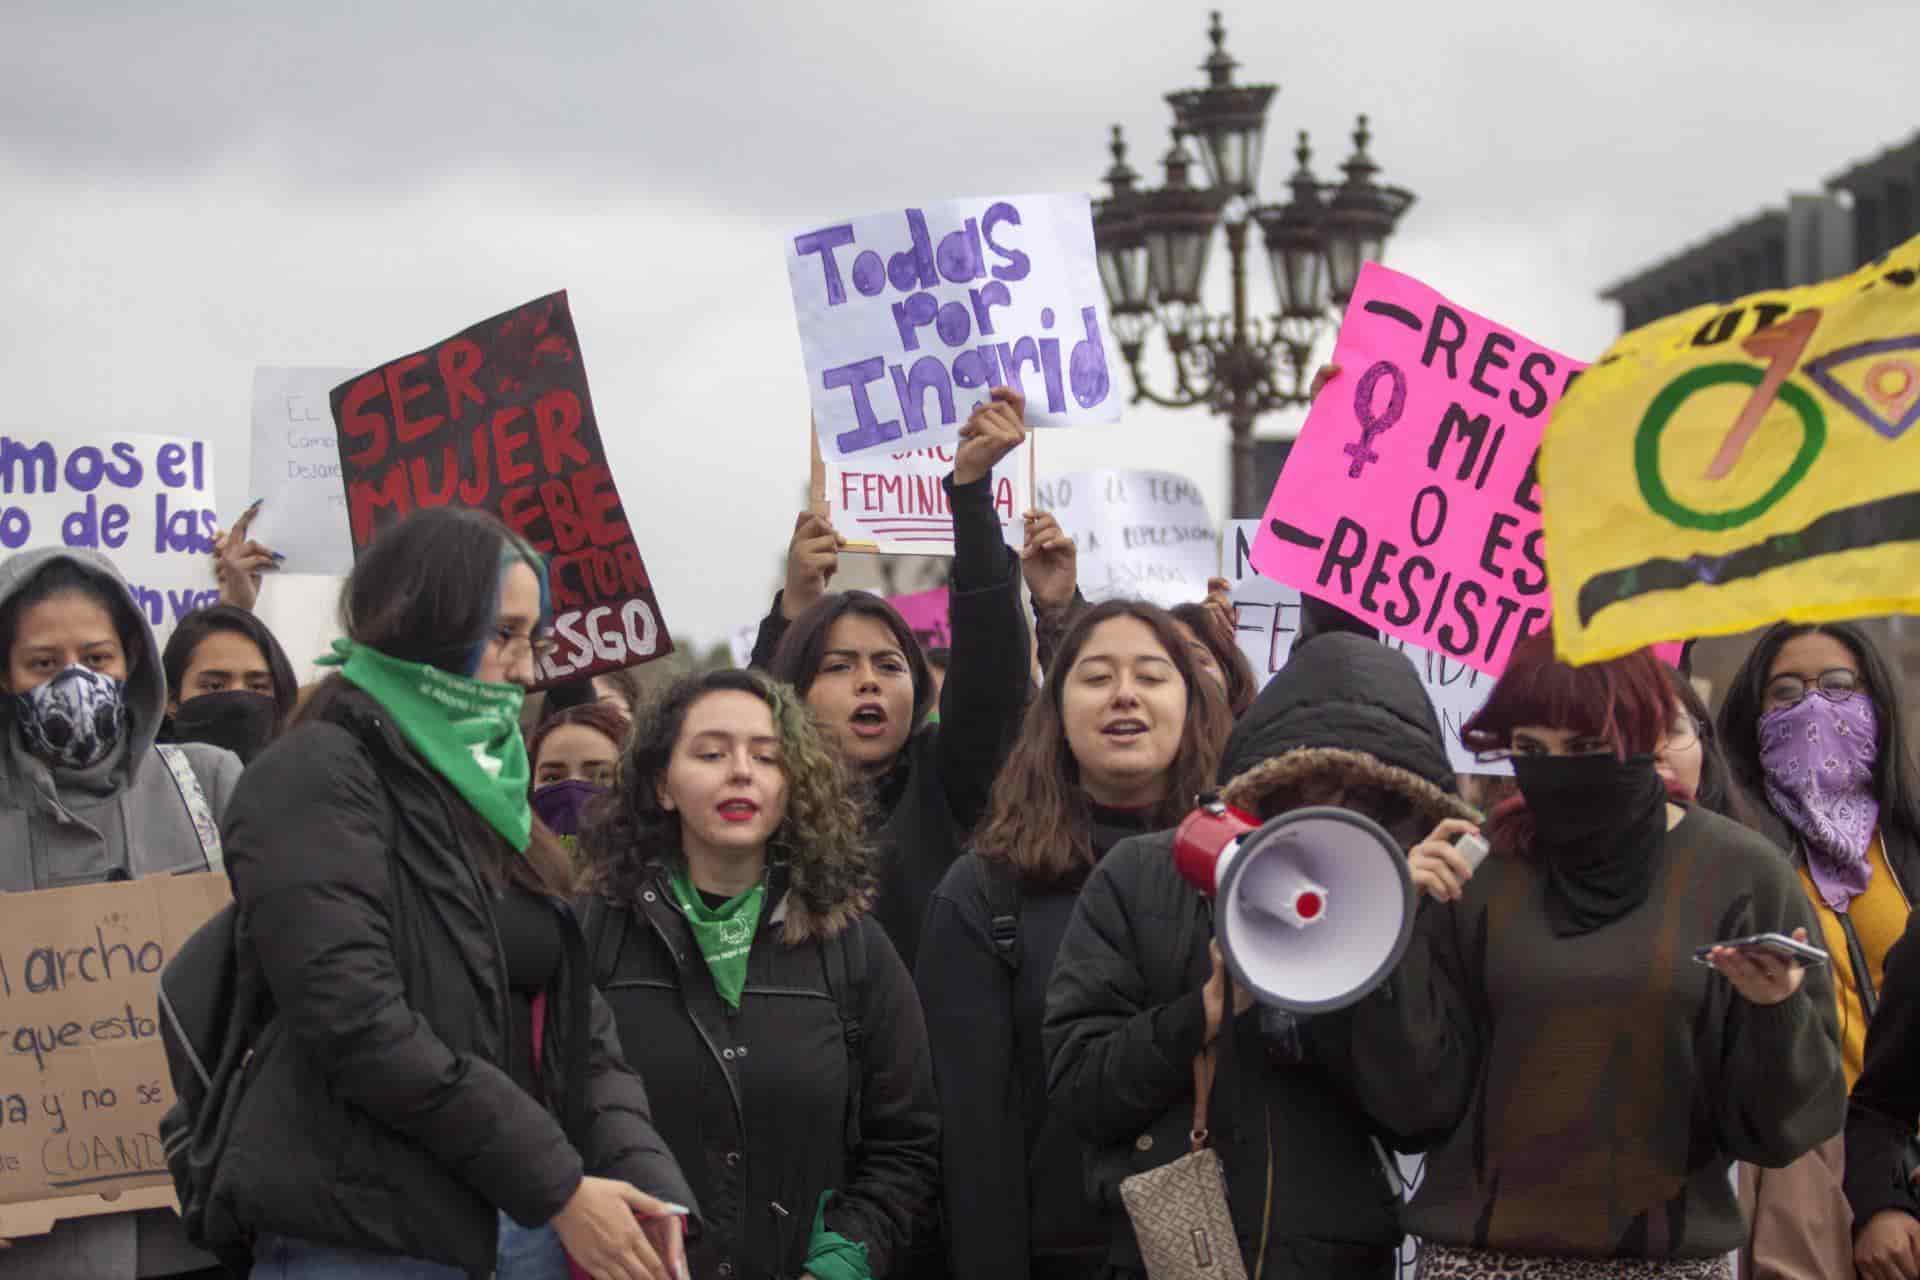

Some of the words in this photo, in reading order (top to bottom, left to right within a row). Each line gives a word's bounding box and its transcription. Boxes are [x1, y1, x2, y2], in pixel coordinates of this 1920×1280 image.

[793, 201, 1031, 307] Todas
[890, 280, 1012, 352] por
[340, 337, 489, 467] SER
[0, 436, 144, 495] mos
[155, 441, 205, 492] el
[347, 390, 591, 546] MUJER
[1426, 401, 1506, 491] MI
[0, 505, 32, 549] o
[61, 493, 131, 549] de
[154, 493, 217, 554] las
[81, 1088, 118, 1112] no
